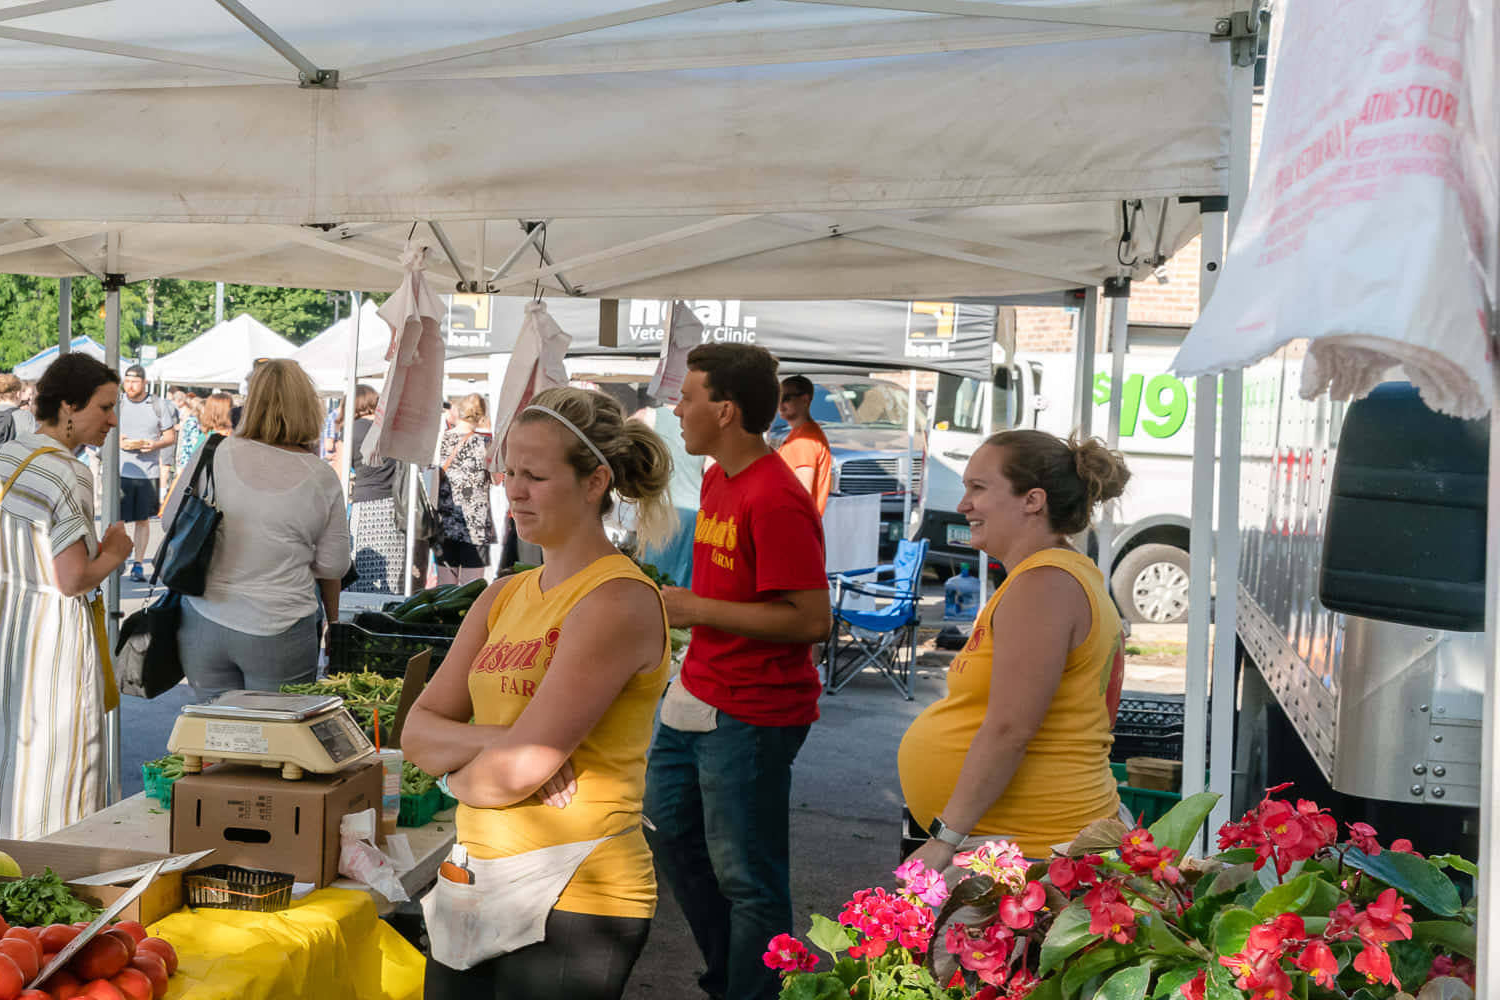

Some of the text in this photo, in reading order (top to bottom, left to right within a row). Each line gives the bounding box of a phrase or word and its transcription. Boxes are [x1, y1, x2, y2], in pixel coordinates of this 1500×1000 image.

[713, 327, 756, 343] Clinic
[905, 341, 955, 357] heal.
[501, 676, 536, 697] FAR
